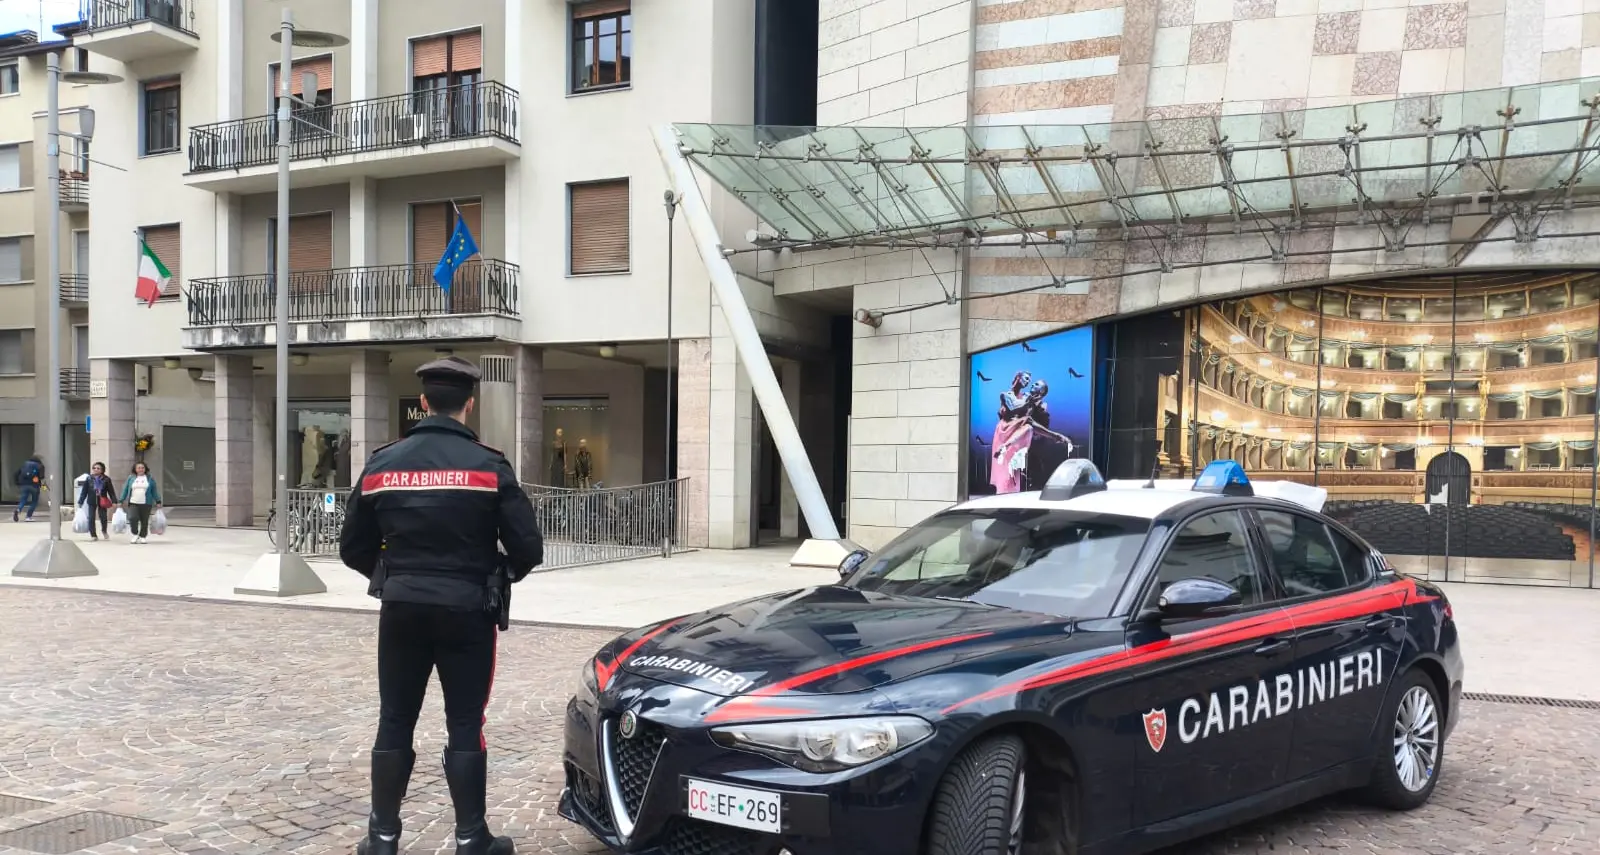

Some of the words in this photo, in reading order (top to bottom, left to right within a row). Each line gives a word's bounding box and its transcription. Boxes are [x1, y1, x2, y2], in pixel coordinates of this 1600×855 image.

[382, 471, 469, 486] CARABINIERI
[629, 655, 755, 693] CARABINIERI
[1177, 647, 1383, 744] CARABINIERI
